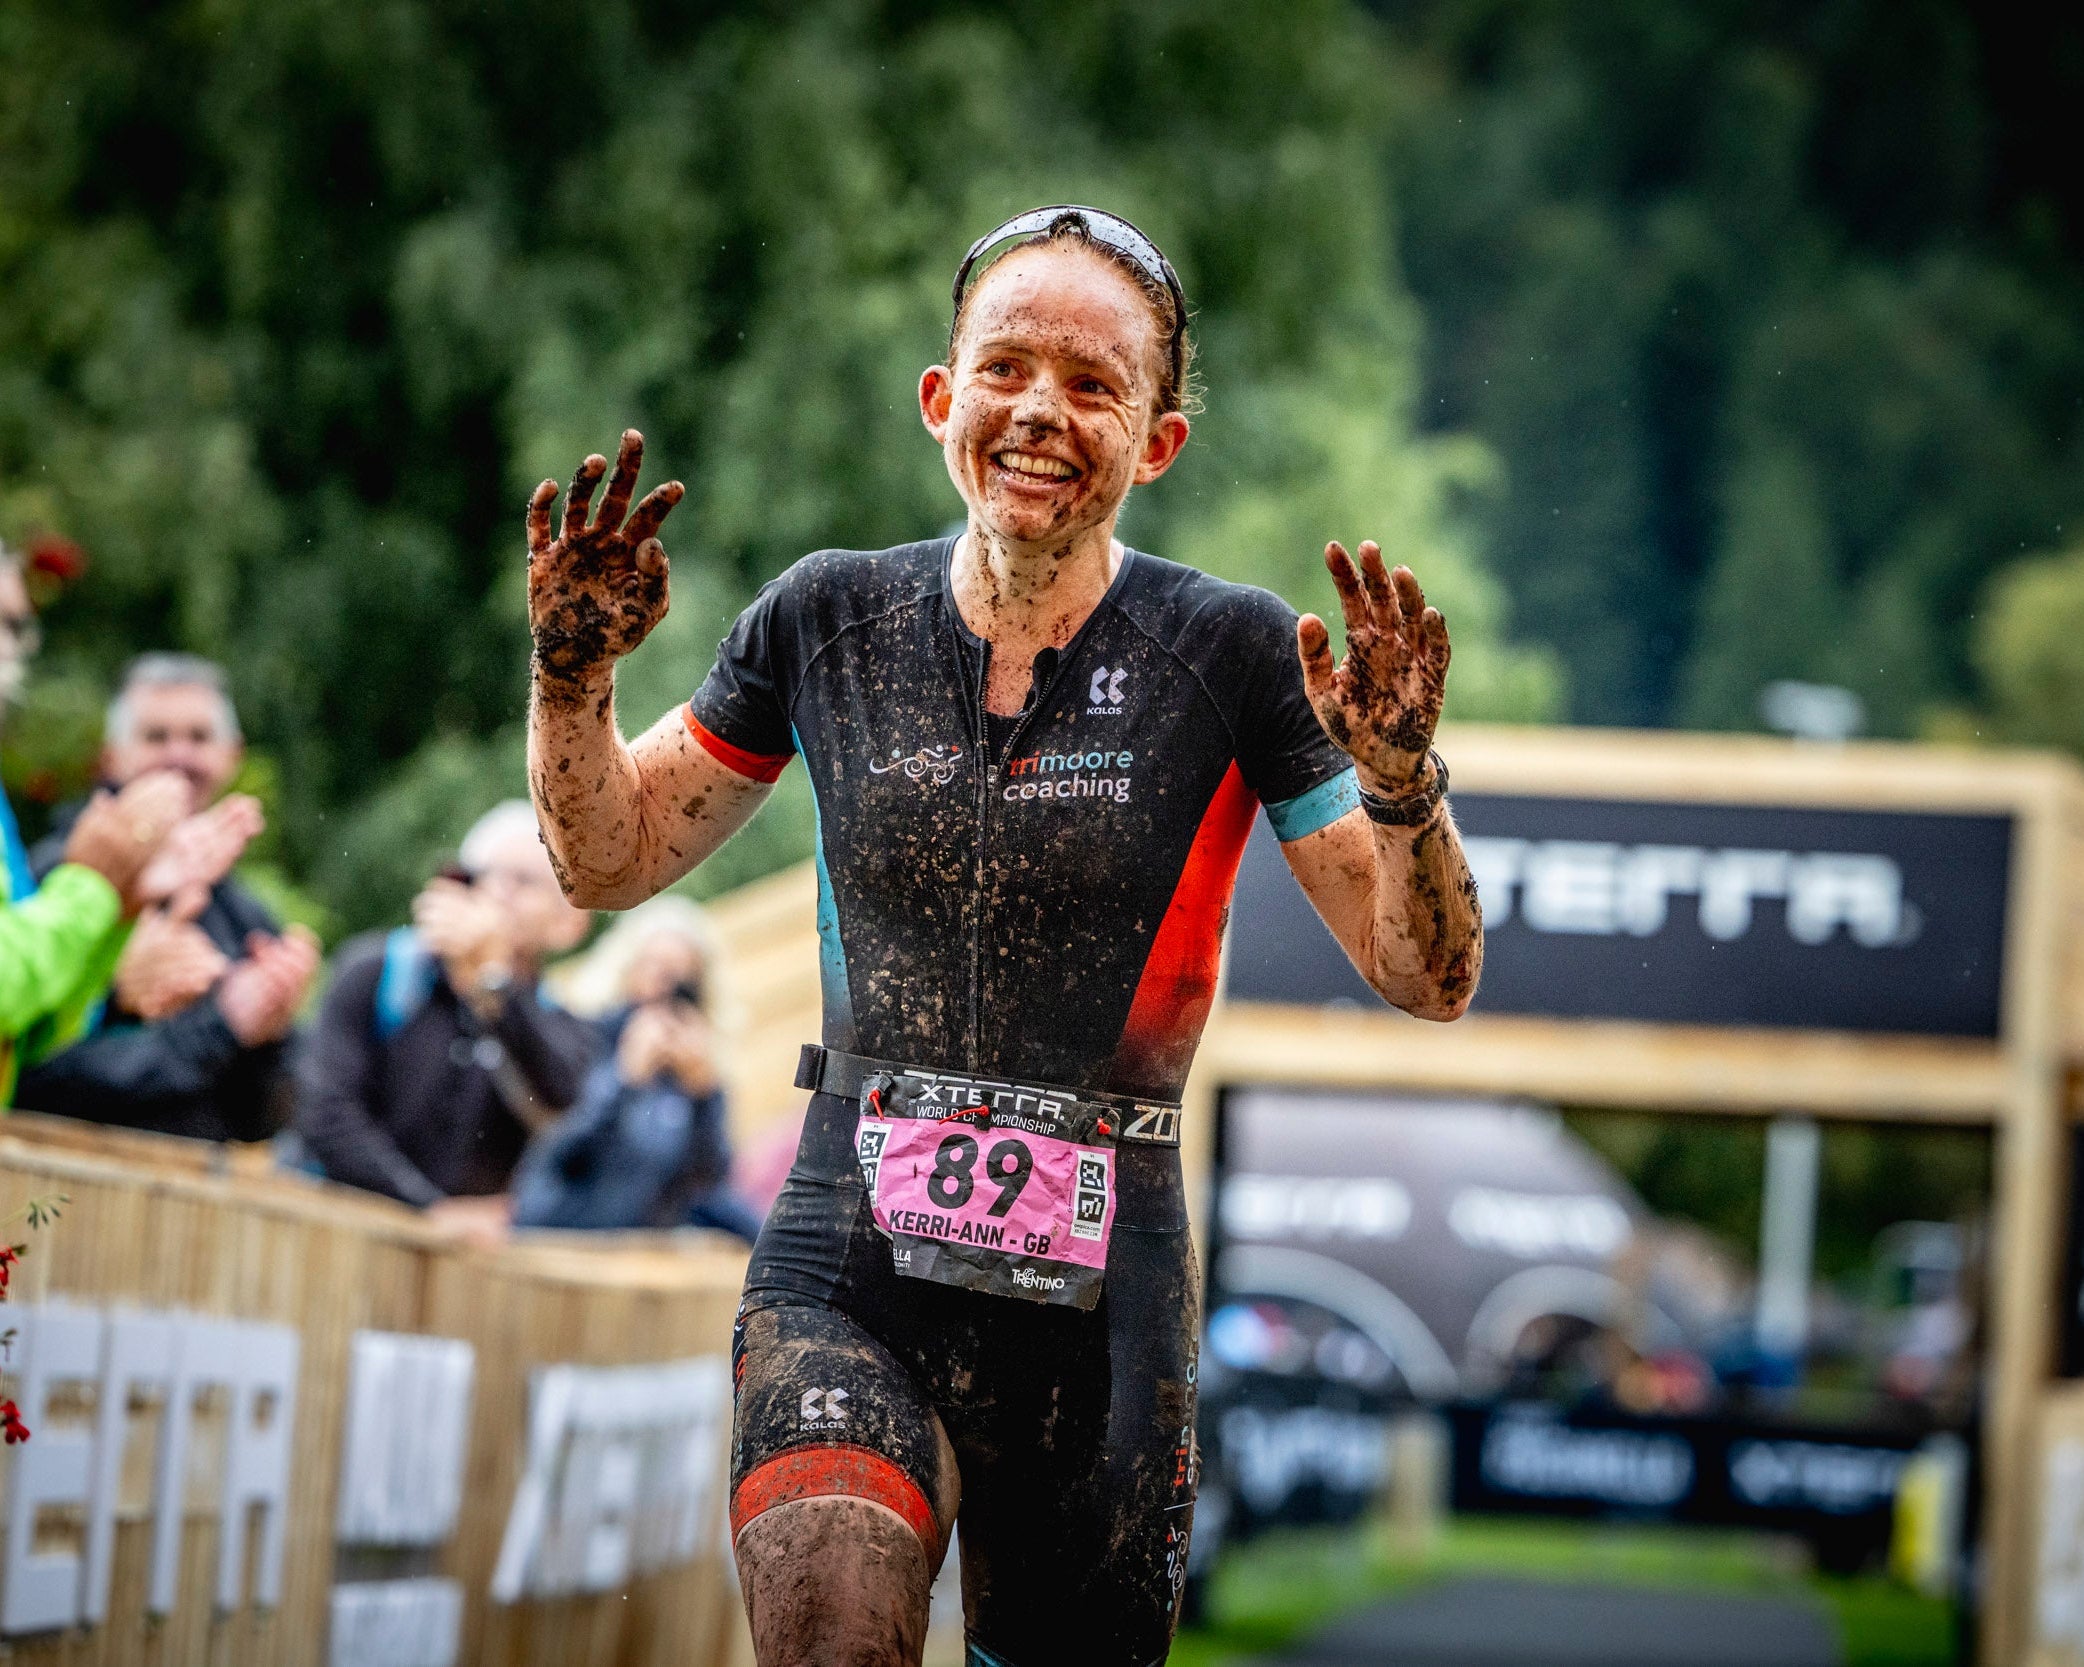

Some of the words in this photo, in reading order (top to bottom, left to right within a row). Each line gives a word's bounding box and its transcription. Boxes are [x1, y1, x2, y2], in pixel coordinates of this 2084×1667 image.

[1009, 750, 1134, 777] trimoore
[1002, 773, 1132, 803] coaching
[1462, 835, 1902, 948] TERRA
[916, 1105, 959, 1120] WORLD
[962, 1111, 1056, 1135] CMPIONSHIP
[1123, 1104, 1182, 1141] ZO
[927, 1133, 1034, 1218] 89
[888, 1209, 1005, 1248] KERRI-ANN
[1023, 1232, 1051, 1255] GB
[1011, 1268, 1065, 1291] TRENTINO
